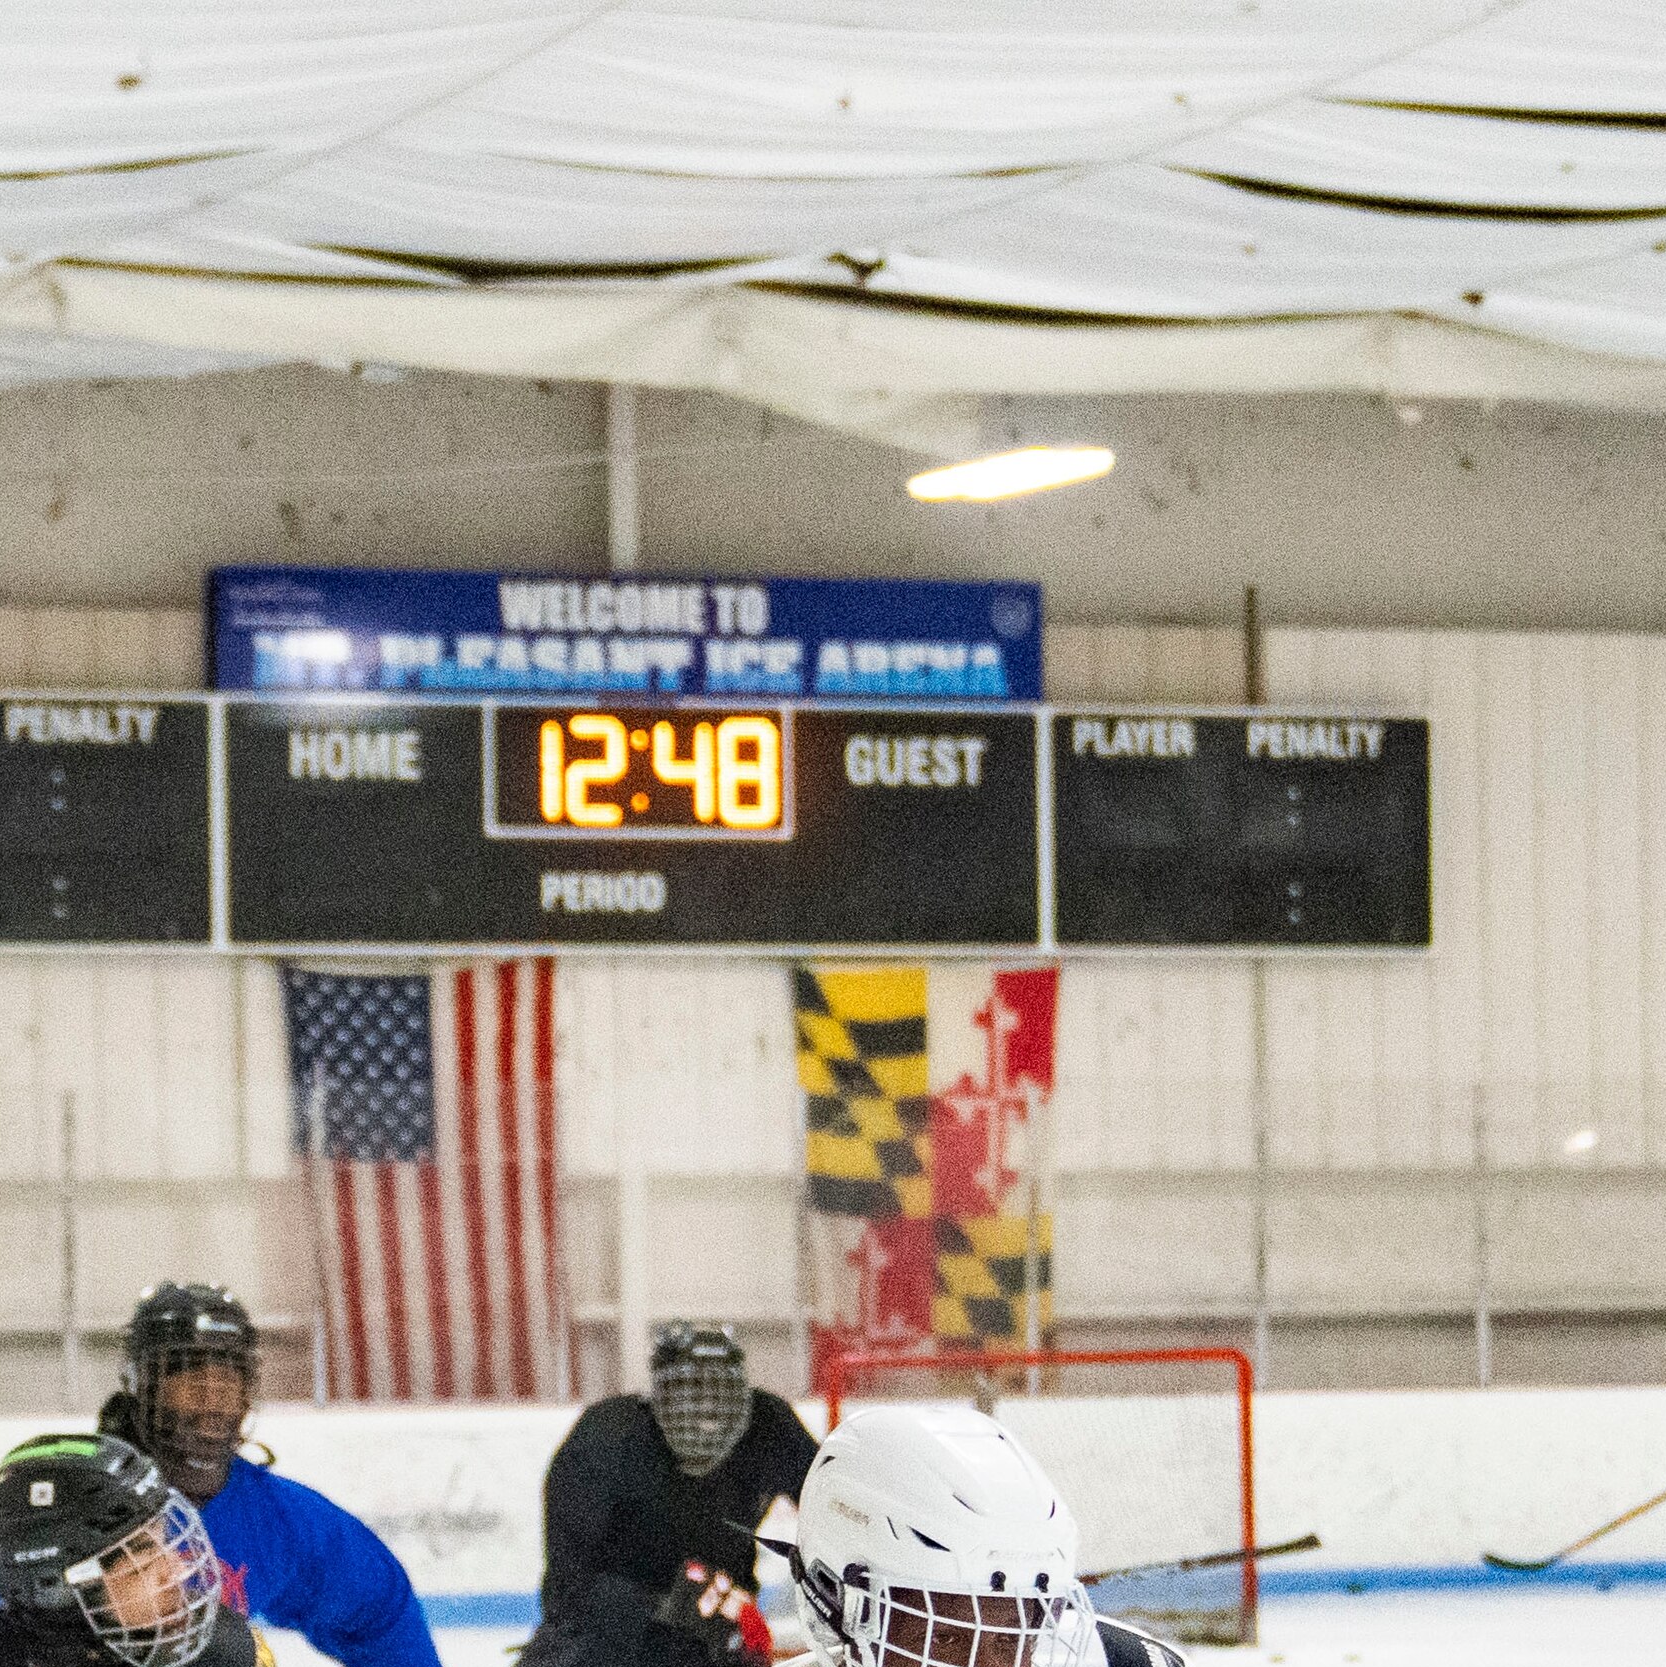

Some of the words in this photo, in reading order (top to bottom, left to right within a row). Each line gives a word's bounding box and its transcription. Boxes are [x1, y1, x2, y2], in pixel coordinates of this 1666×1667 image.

[497, 580, 706, 634] WELCOME
[713, 585, 770, 636] TO
[378, 634, 691, 693] PLEASANT
[705, 638, 806, 695] ICE
[816, 639, 1011, 698] ARENA
[3, 705, 158, 745] PENALTY
[1071, 719, 1197, 758] PLAYER
[1246, 721, 1385, 759] PENALTY
[288, 728, 423, 782] HOME
[538, 713, 784, 829] 12:48
[843, 734, 989, 788] GUEST
[539, 871, 668, 914] PERIOD
